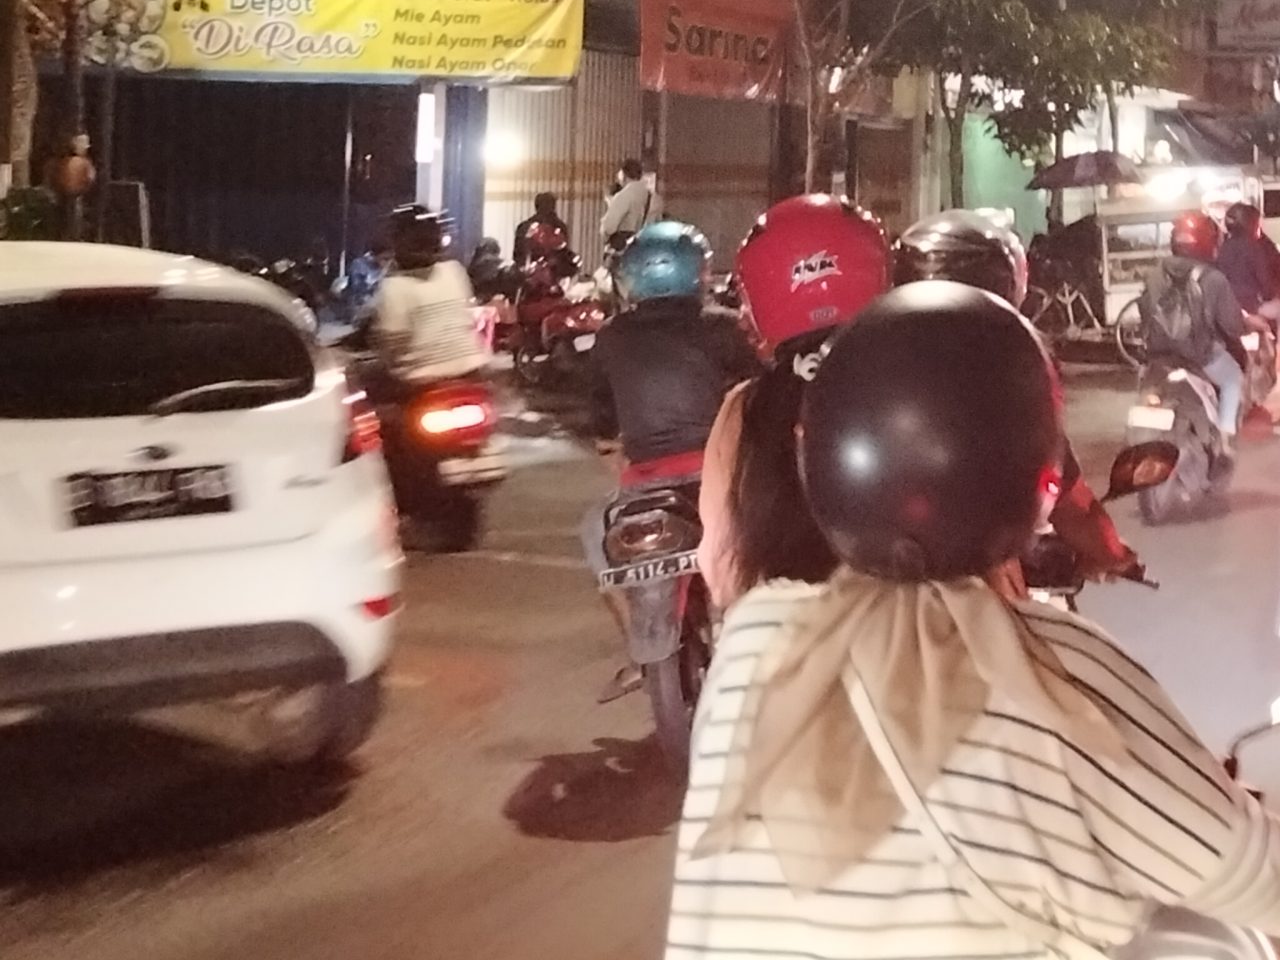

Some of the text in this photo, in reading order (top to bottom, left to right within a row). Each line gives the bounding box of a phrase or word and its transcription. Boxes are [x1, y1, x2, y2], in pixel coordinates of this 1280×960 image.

[393, 8, 481, 27] Mie Ayam
[392, 31, 568, 50] Nasi Ayam Pedan
[391, 55, 432, 70] Nasi
[435, 56, 487, 74] Ayam
